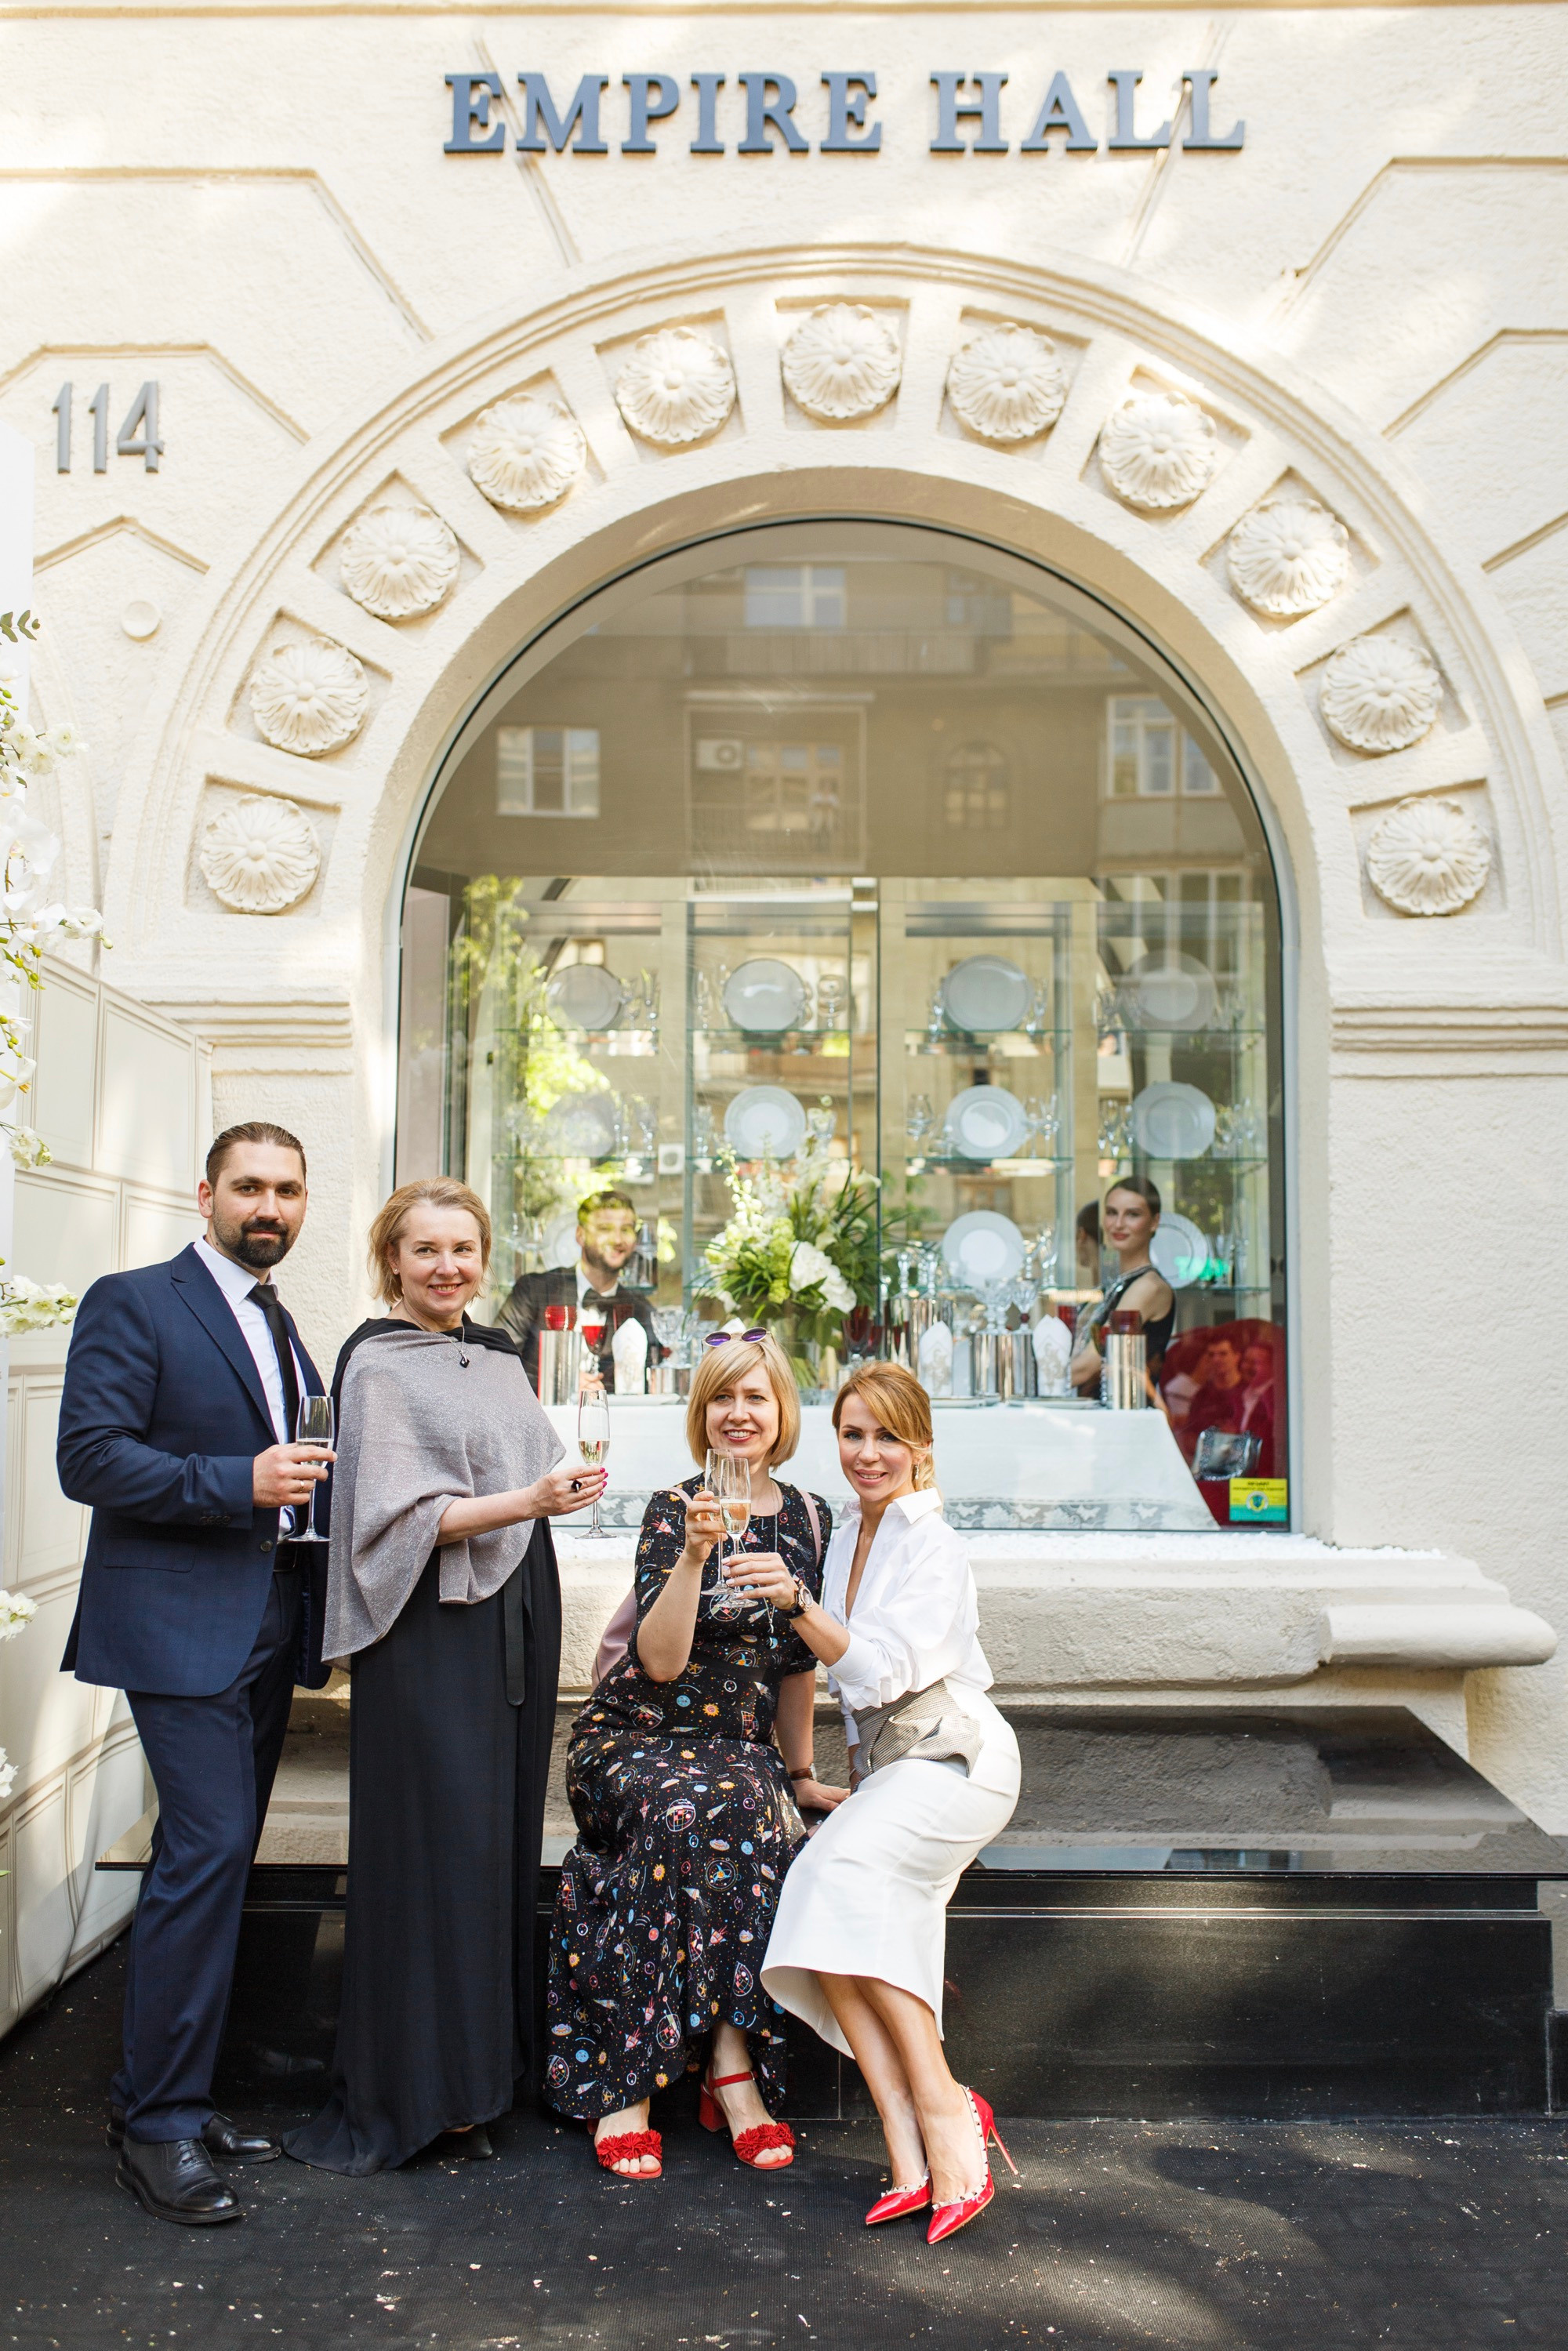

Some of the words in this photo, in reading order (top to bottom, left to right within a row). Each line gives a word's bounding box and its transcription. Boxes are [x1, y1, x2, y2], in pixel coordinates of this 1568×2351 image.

[444, 71, 882, 153] EMPIRE
[930, 70, 1246, 152] HALL
[51, 381, 165, 474] 114
